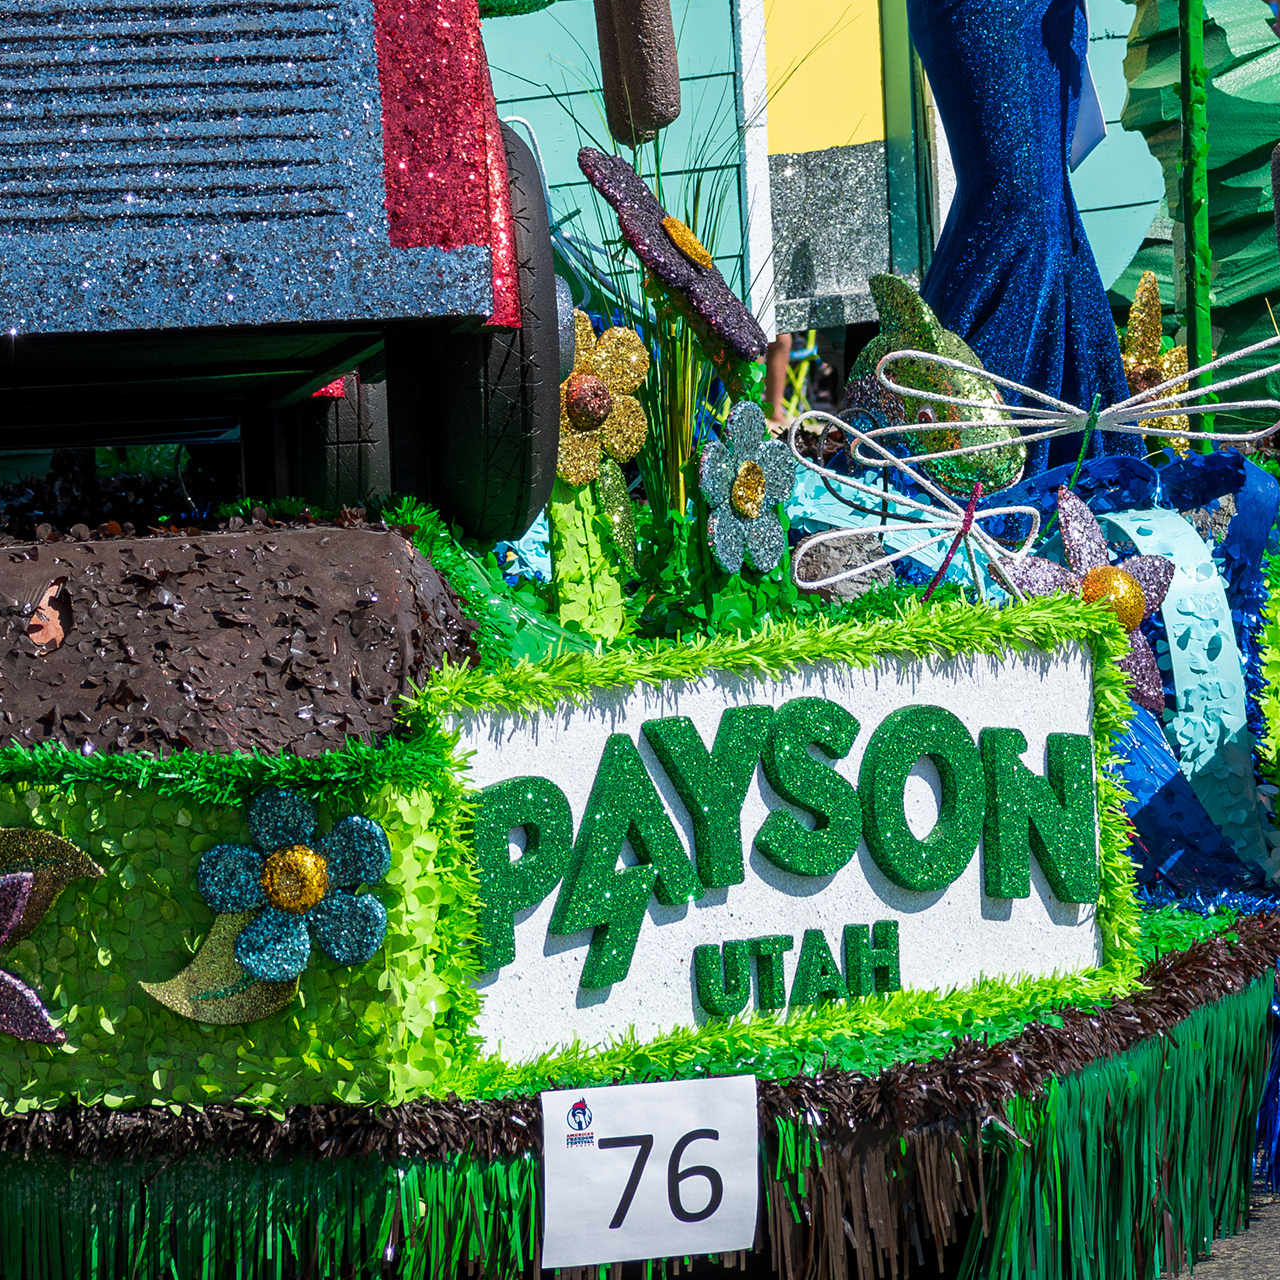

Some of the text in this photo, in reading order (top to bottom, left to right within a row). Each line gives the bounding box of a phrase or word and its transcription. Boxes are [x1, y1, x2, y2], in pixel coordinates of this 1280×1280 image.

[470, 696, 1099, 989] PAYSON
[693, 919, 902, 1017] UTAH
[597, 1128, 724, 1230] 76
